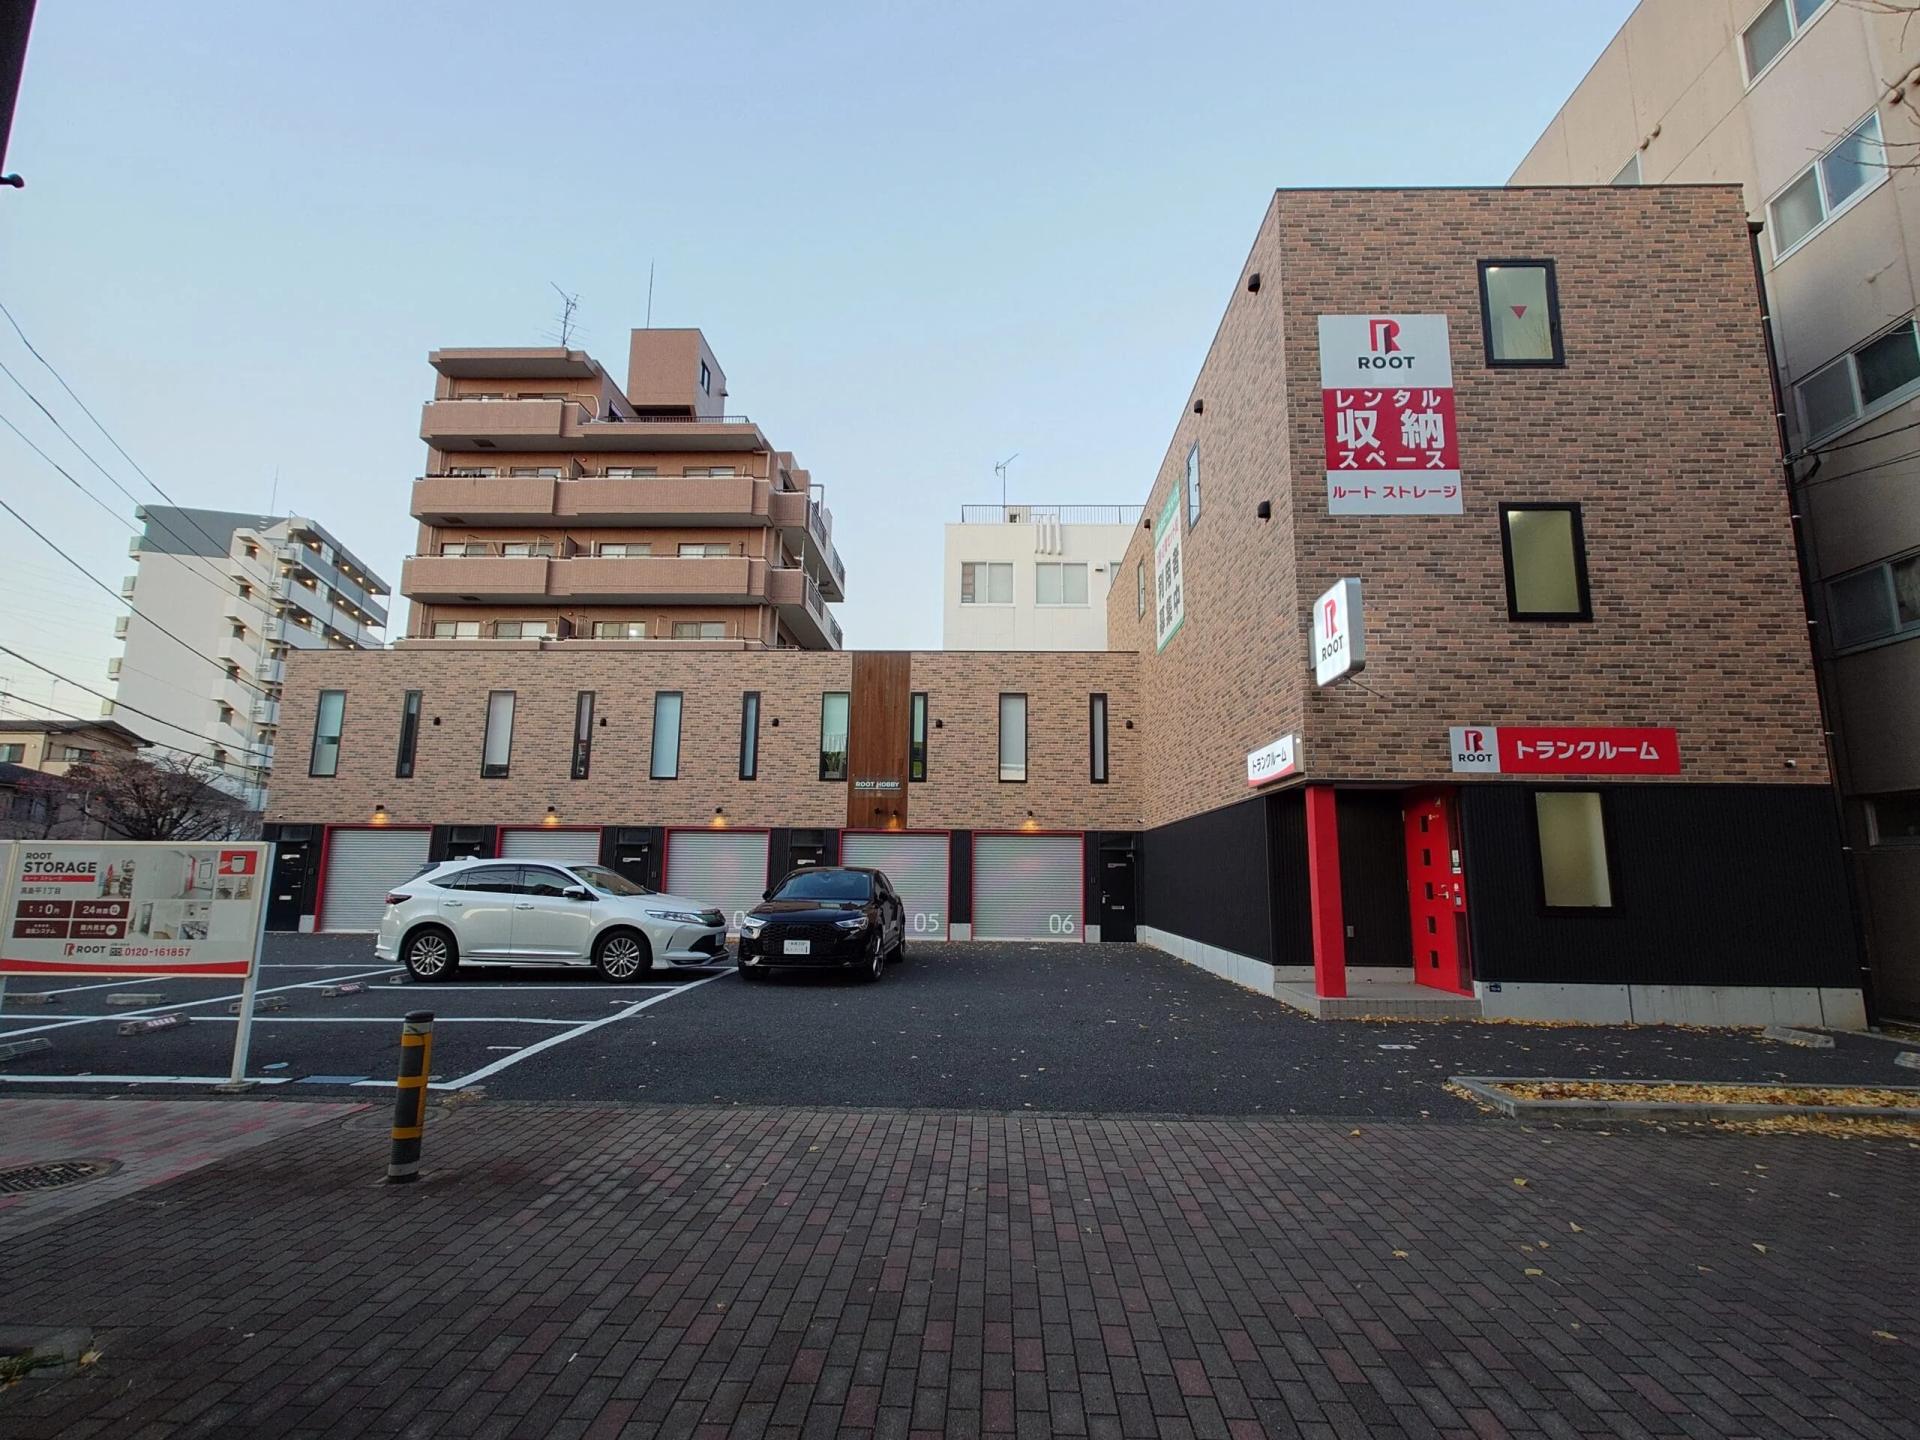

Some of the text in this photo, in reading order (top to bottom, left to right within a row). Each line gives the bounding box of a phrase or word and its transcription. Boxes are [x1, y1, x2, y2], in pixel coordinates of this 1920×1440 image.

[1358, 356, 1416, 369] ROOT
[1336, 389, 1441, 408] レンタル
[1336, 408, 1446, 449] 収納
[1339, 450, 1446, 469] スペース
[1333, 485, 1457, 499] ルート ストレージ
[1321, 635, 1344, 661] ROOT
[1458, 753, 1493, 763] ROOT
[1516, 740, 1660, 760] トランクルーム
[1252, 746, 1287, 774] トランクルーム
[26, 852, 53, 860] ROOT
[23, 861, 98, 873] STORAGE
[914, 913, 939, 932] 05
[1049, 914, 1075, 934] 06
[76, 945, 107, 954] ROOT
[124, 947, 192, 957] 0120-161857
